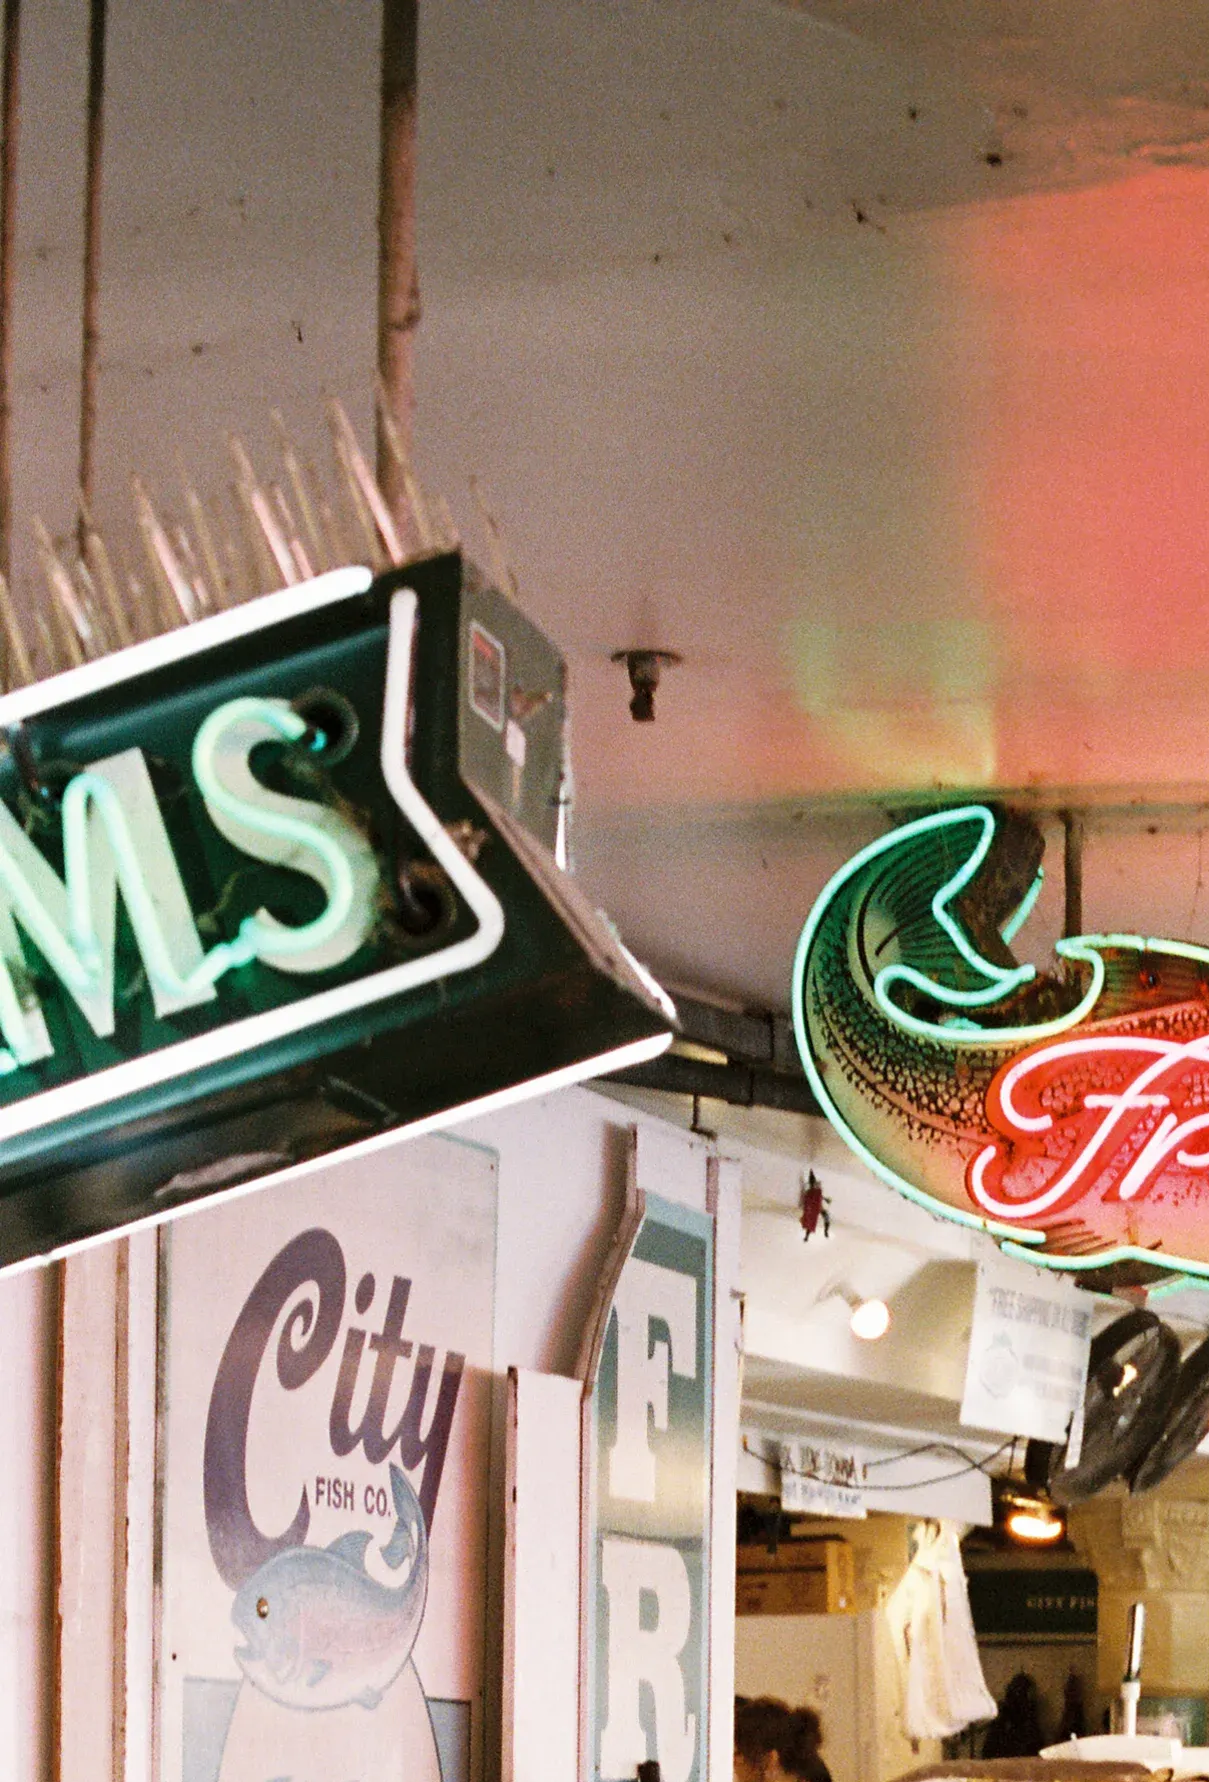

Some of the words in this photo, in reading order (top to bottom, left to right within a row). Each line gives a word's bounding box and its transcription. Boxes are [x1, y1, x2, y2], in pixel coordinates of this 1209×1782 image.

[203, 1226, 466, 1606] City
[314, 1475, 355, 1512] FISH
[363, 1483, 392, 1518] CO.
